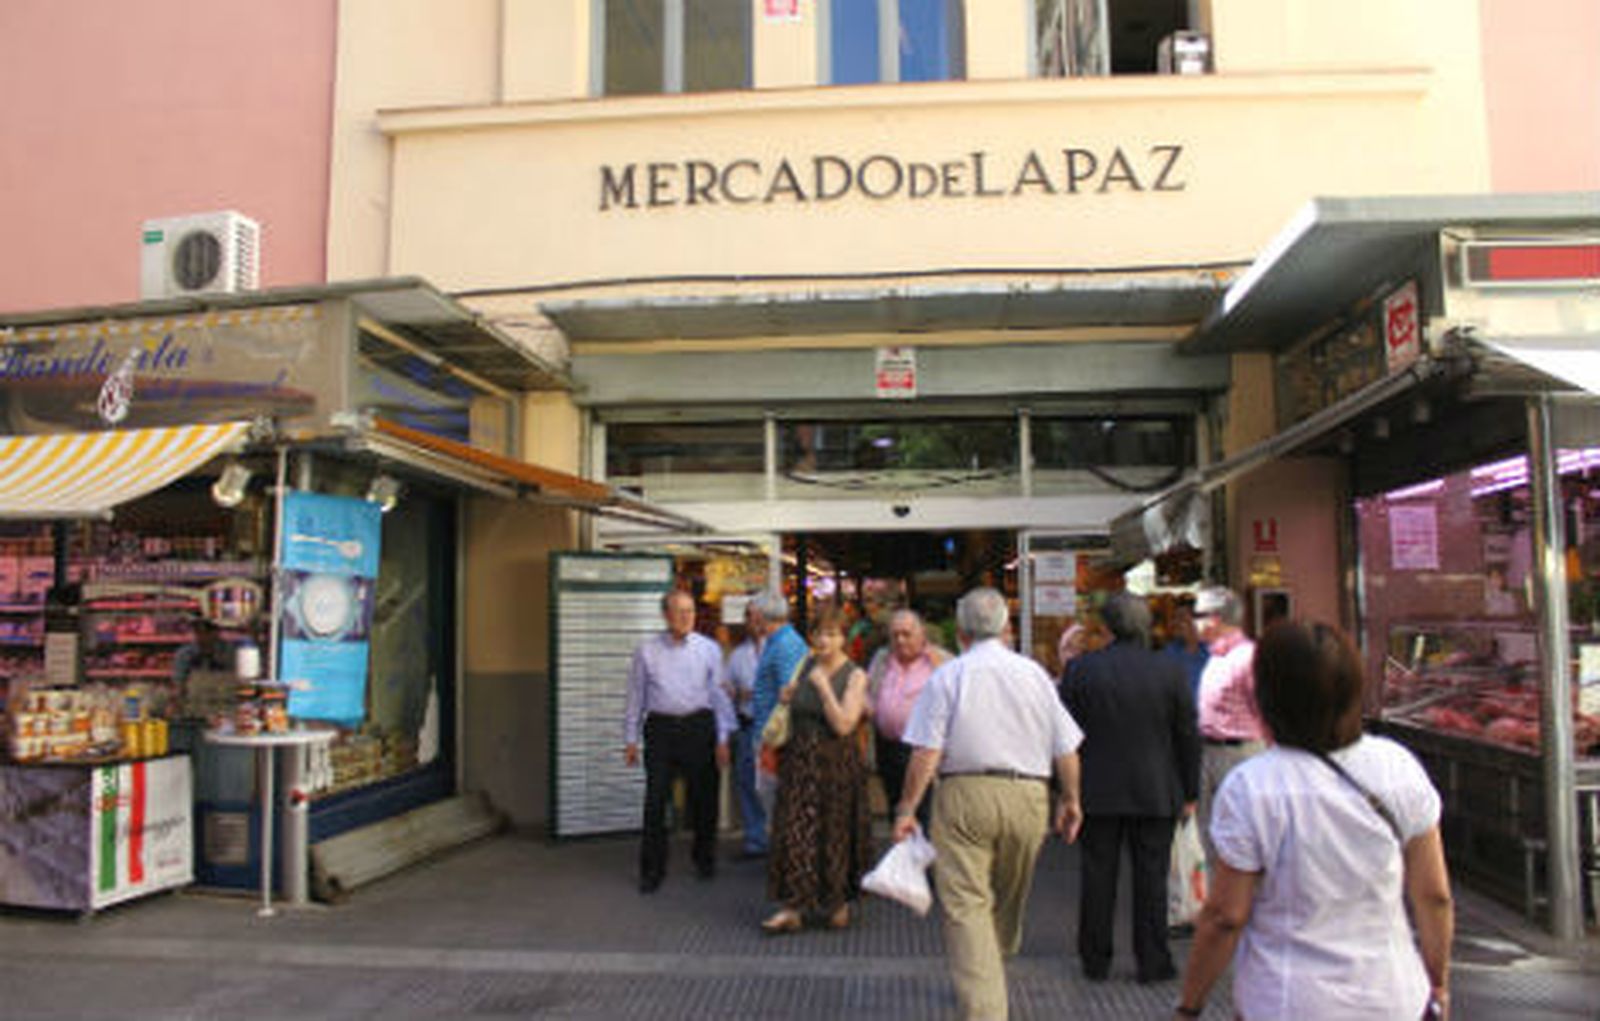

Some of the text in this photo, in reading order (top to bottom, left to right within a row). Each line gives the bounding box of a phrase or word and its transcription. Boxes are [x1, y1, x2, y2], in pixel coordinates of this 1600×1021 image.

[599, 155, 903, 211] MERCADO
[970, 150, 1057, 197] LA
[1061, 145, 1186, 194] PAZ
